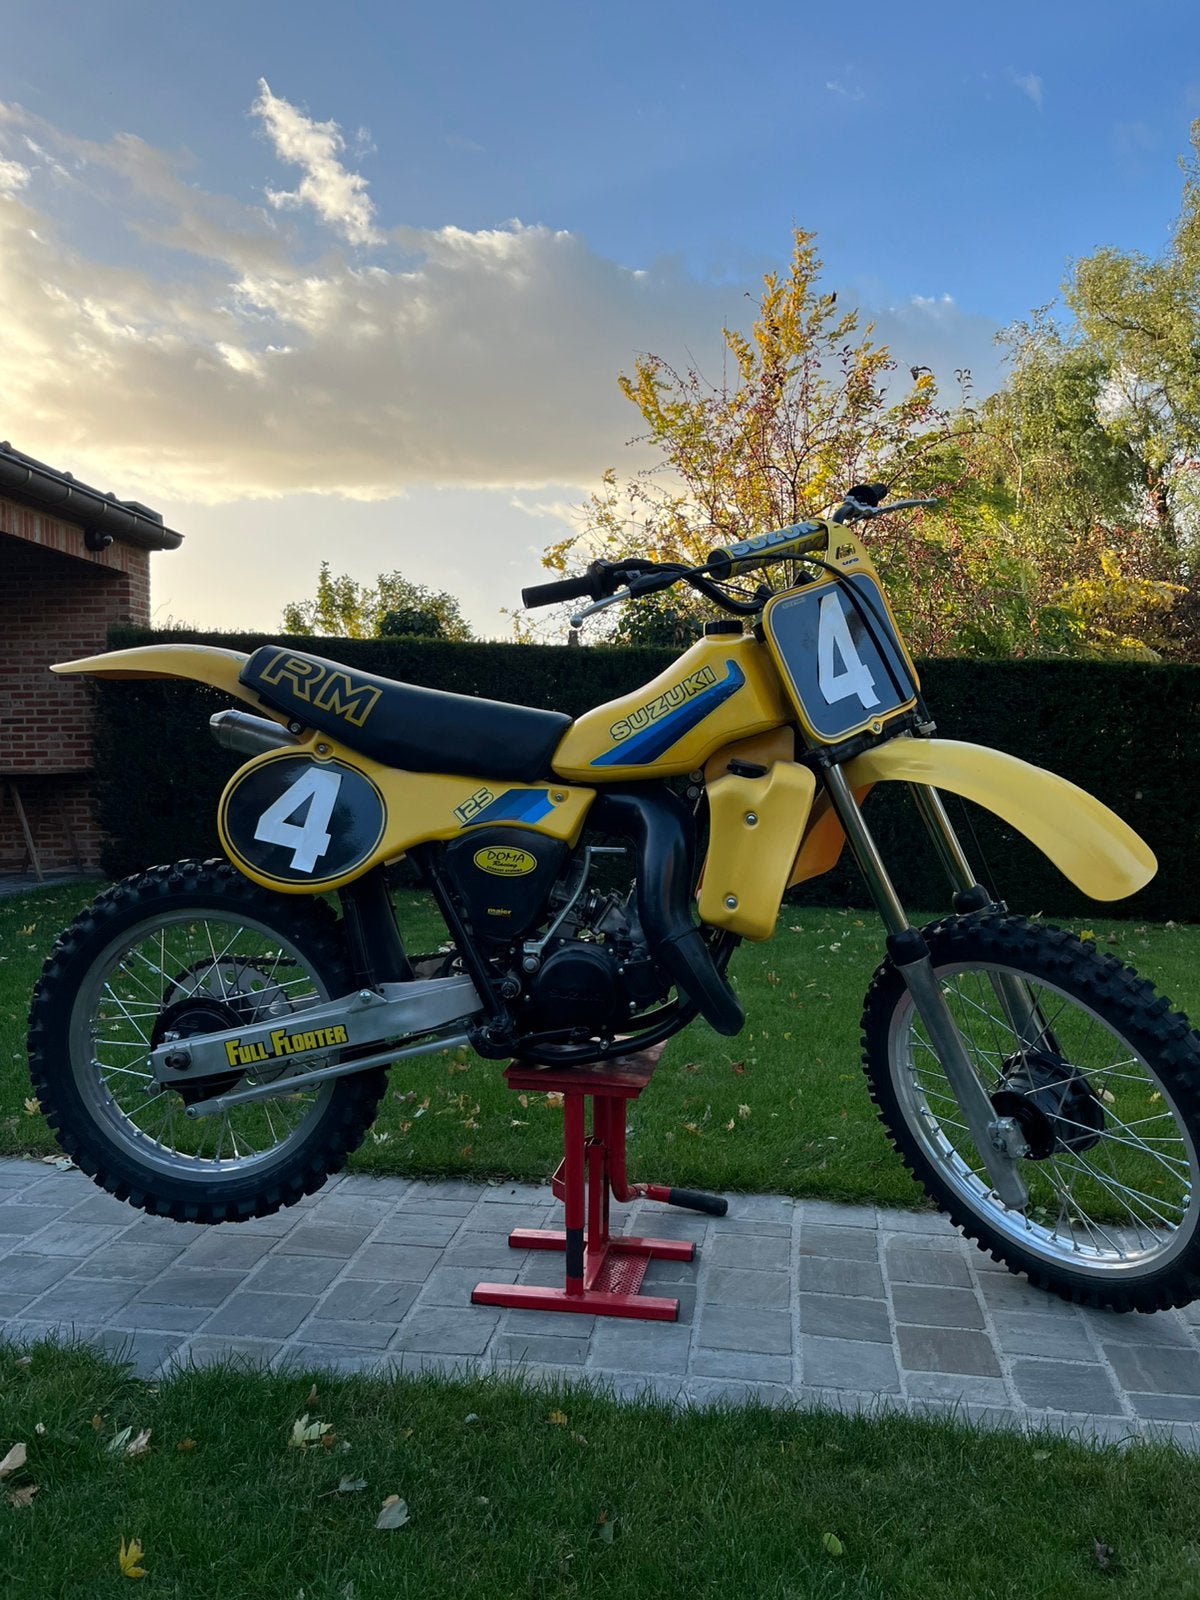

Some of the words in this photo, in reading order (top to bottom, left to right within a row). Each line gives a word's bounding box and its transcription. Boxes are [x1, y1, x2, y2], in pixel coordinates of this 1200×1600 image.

[730, 522, 820, 556] SUZUK
[817, 591, 881, 710] 4
[259, 651, 383, 728] RM
[609, 665, 718, 742] SUZUKI
[253, 766, 343, 874] 4
[453, 786, 495, 824] 125
[486, 850, 525, 864] DOMA
[224, 1038, 270, 1067] FULL
[270, 1024, 349, 1057] FLOATER
